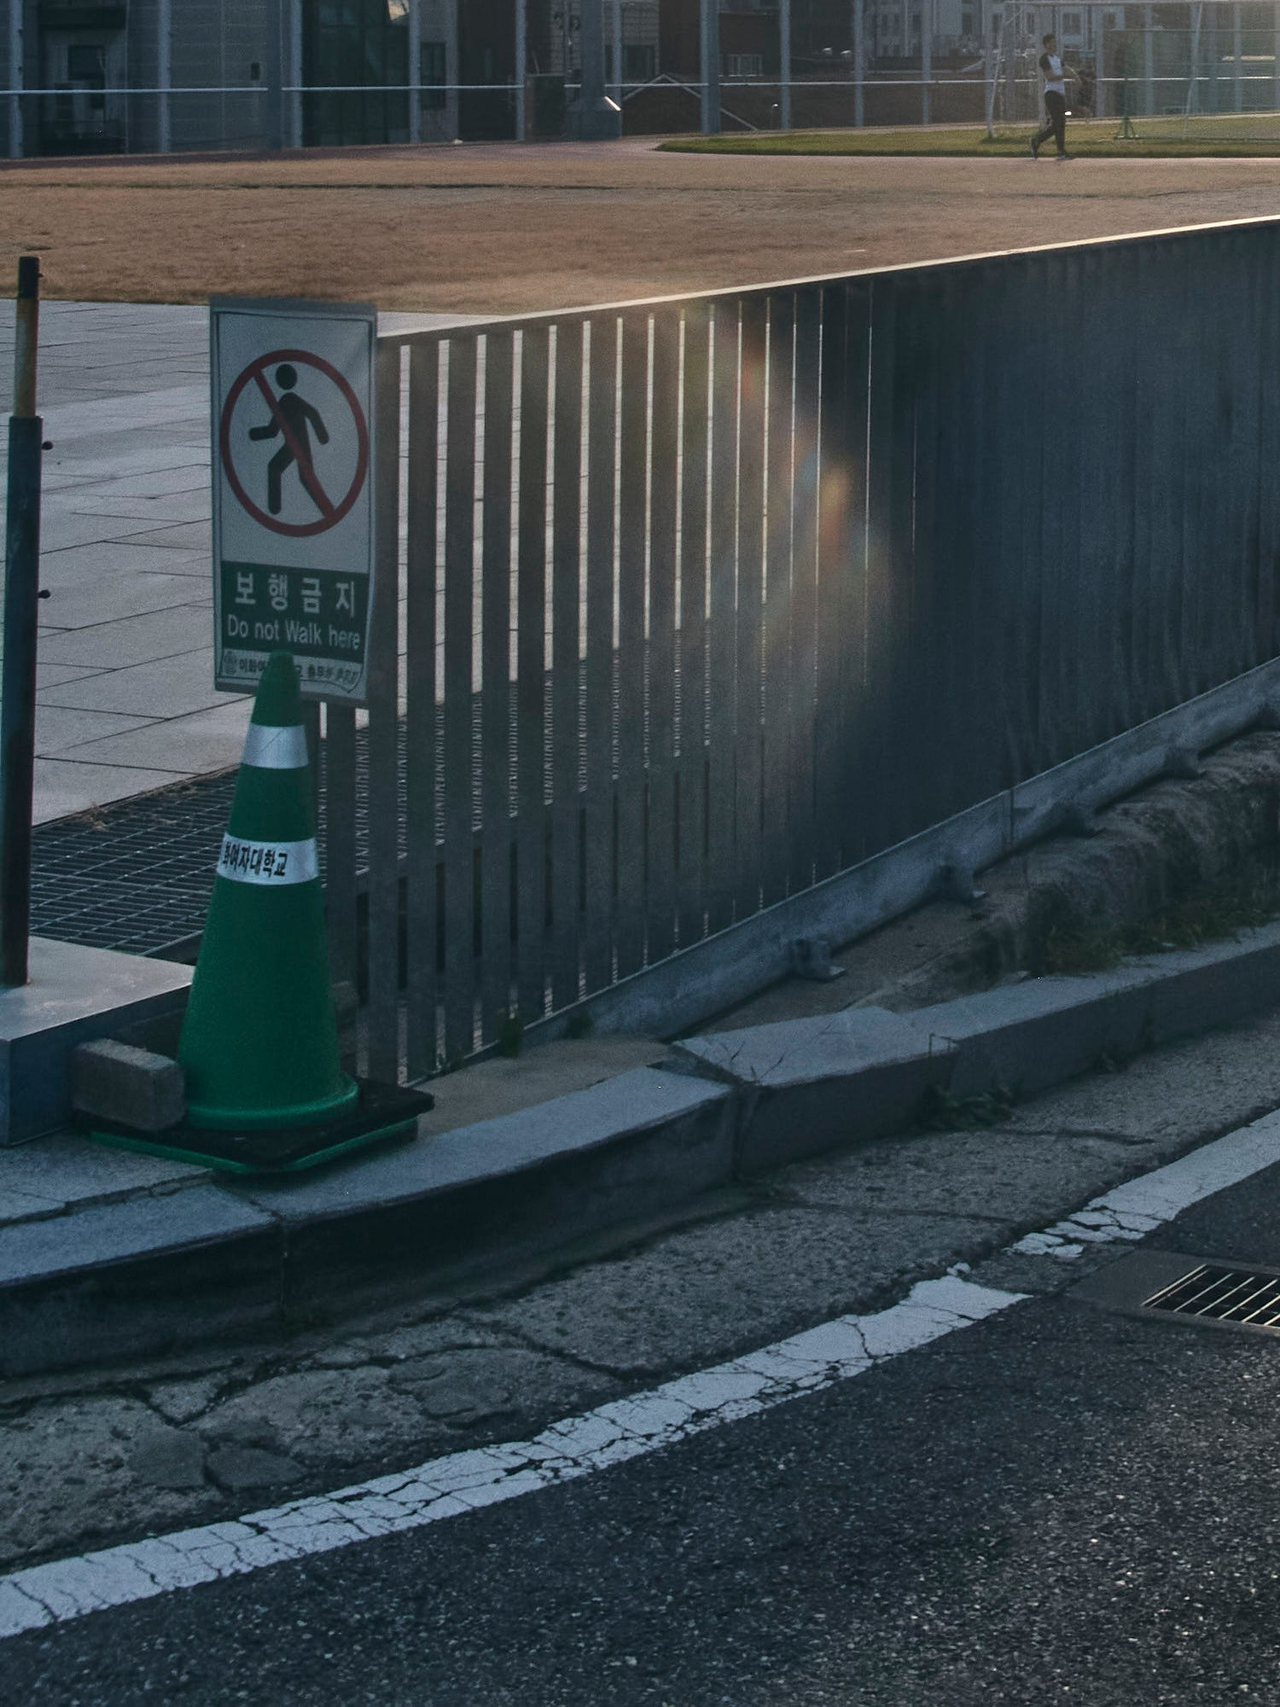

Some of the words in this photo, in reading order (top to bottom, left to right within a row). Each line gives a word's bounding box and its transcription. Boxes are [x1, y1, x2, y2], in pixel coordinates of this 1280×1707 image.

[235, 571, 355, 618] 보행금지
[228, 614, 249, 639] Do
[254, 620, 280, 641] not
[285, 619, 323, 645] Walk
[328, 624, 361, 651] here
